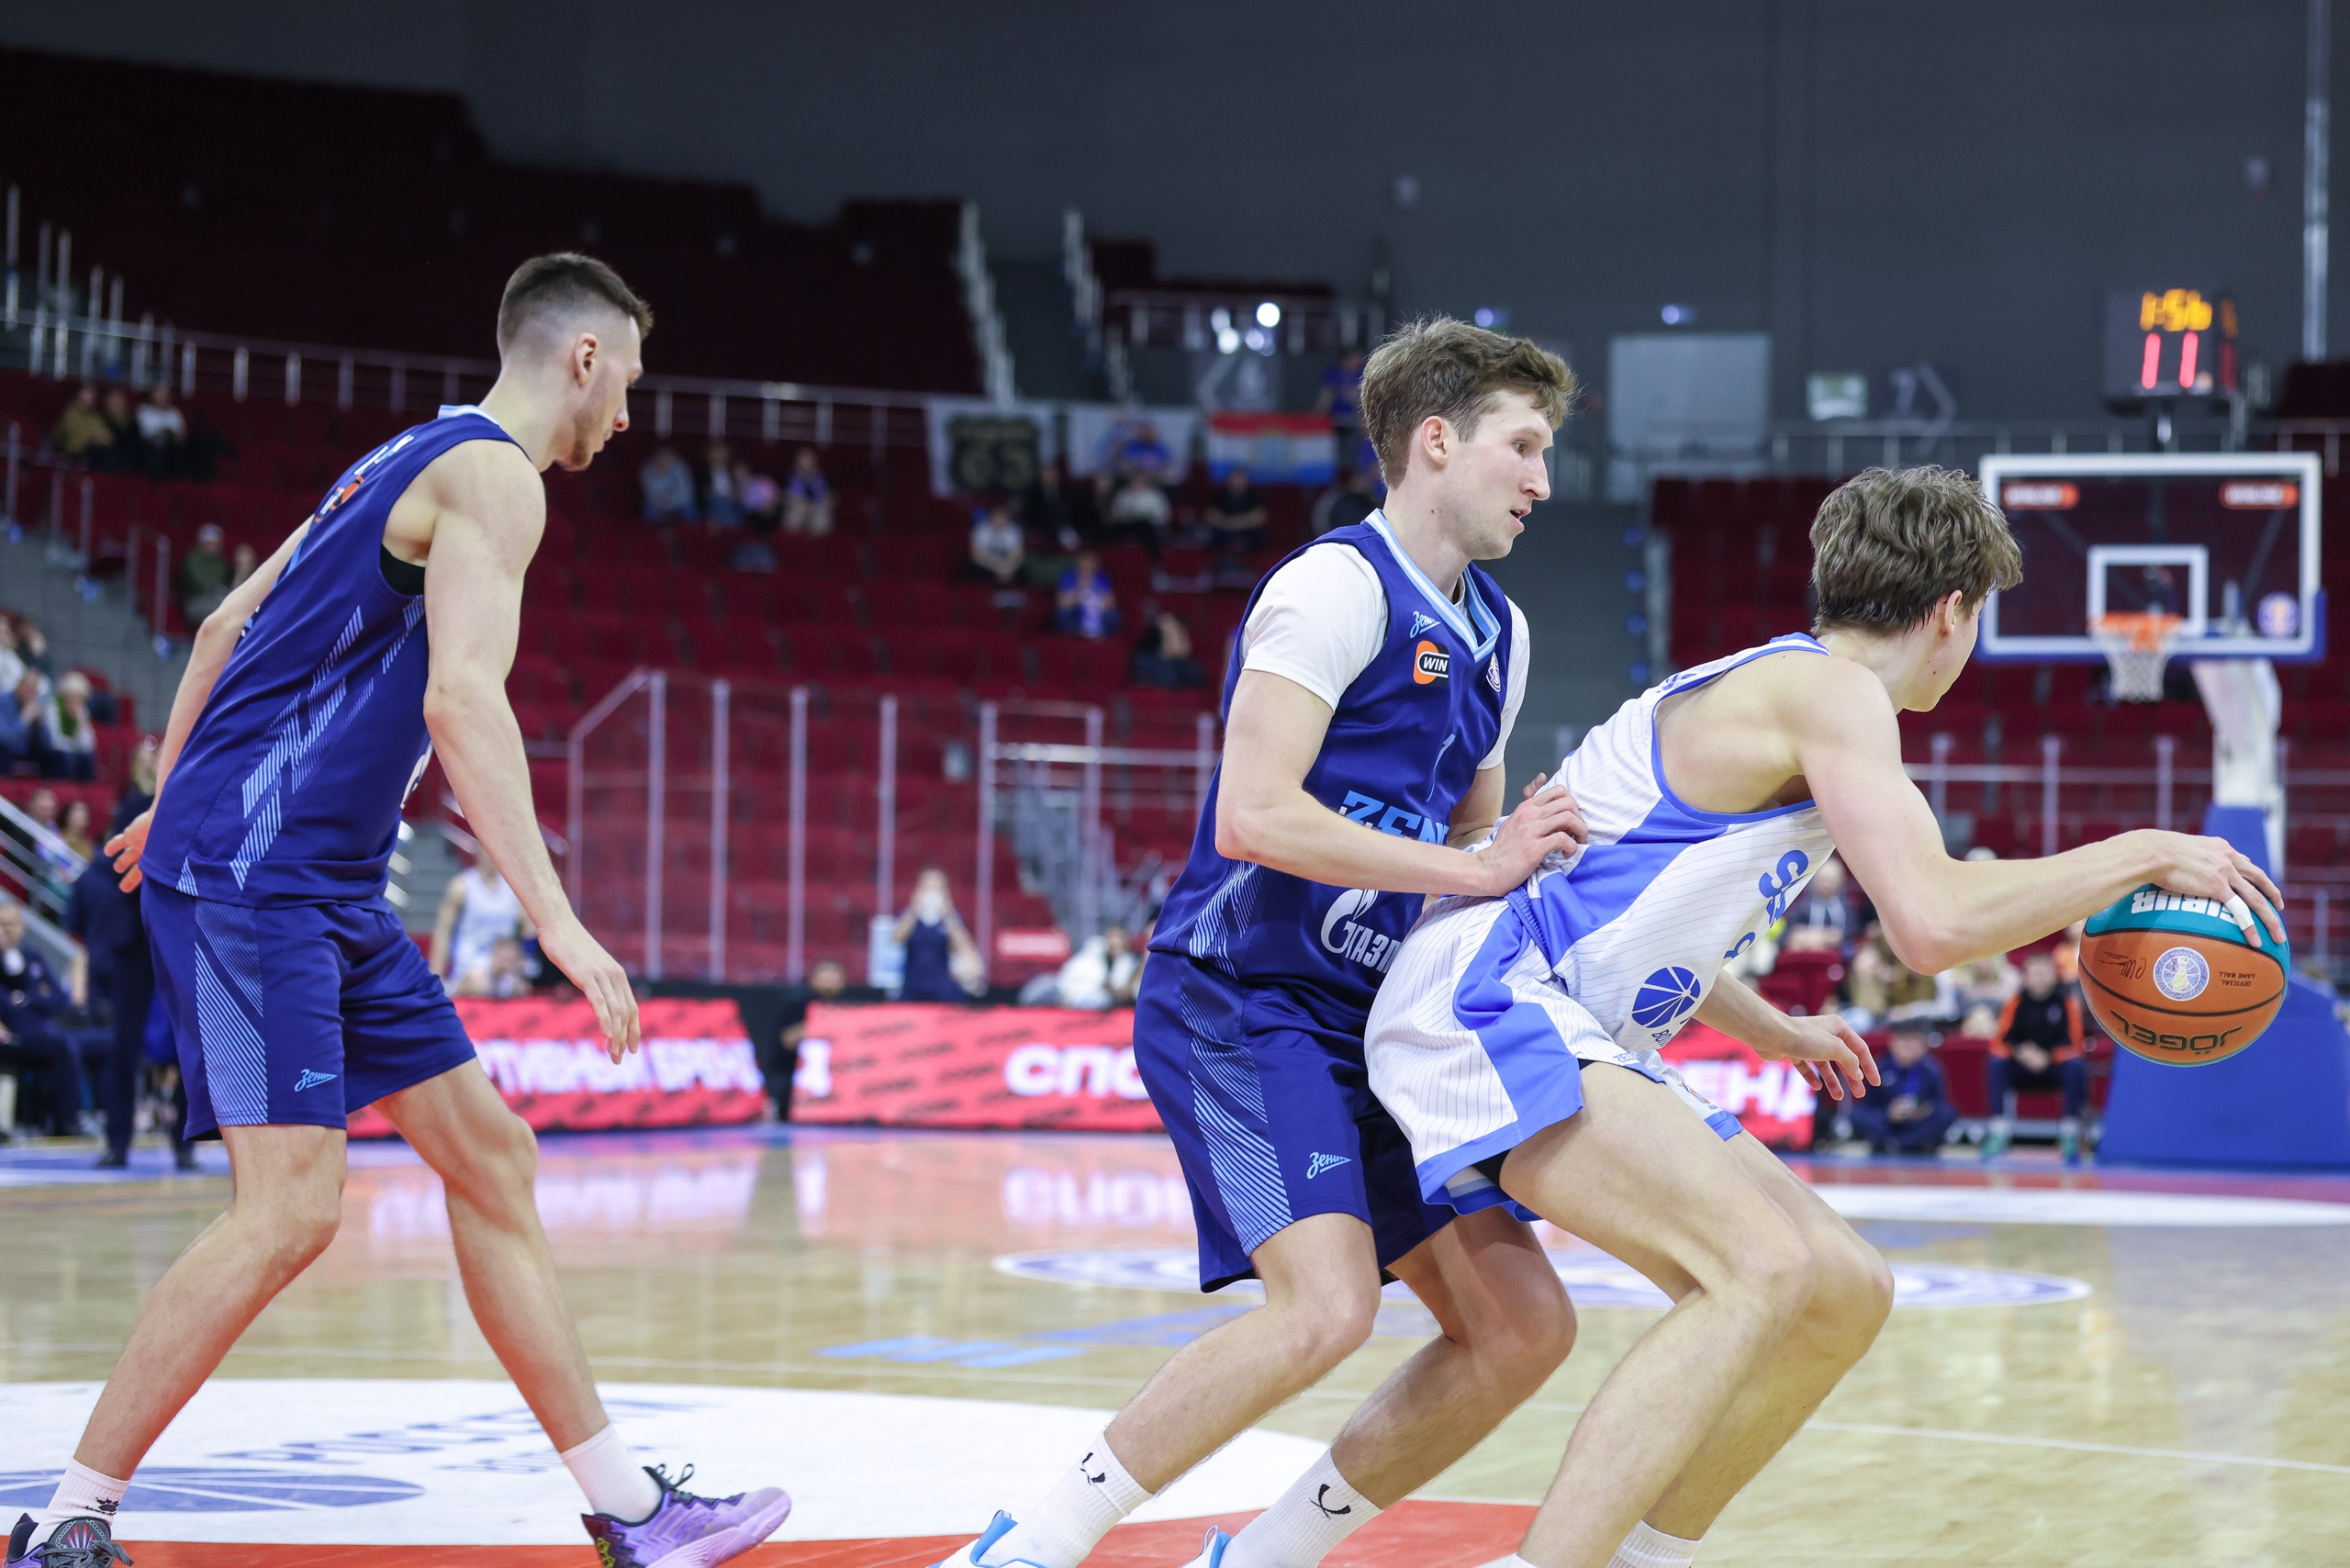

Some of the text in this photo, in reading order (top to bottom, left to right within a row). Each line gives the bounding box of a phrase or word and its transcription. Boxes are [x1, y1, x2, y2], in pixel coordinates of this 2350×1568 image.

[2218, 970, 2256, 980] GAME BALL
[2221, 979, 2253, 988] OFFICIAL
[2109, 1009, 2244, 1055] JÖGEL
